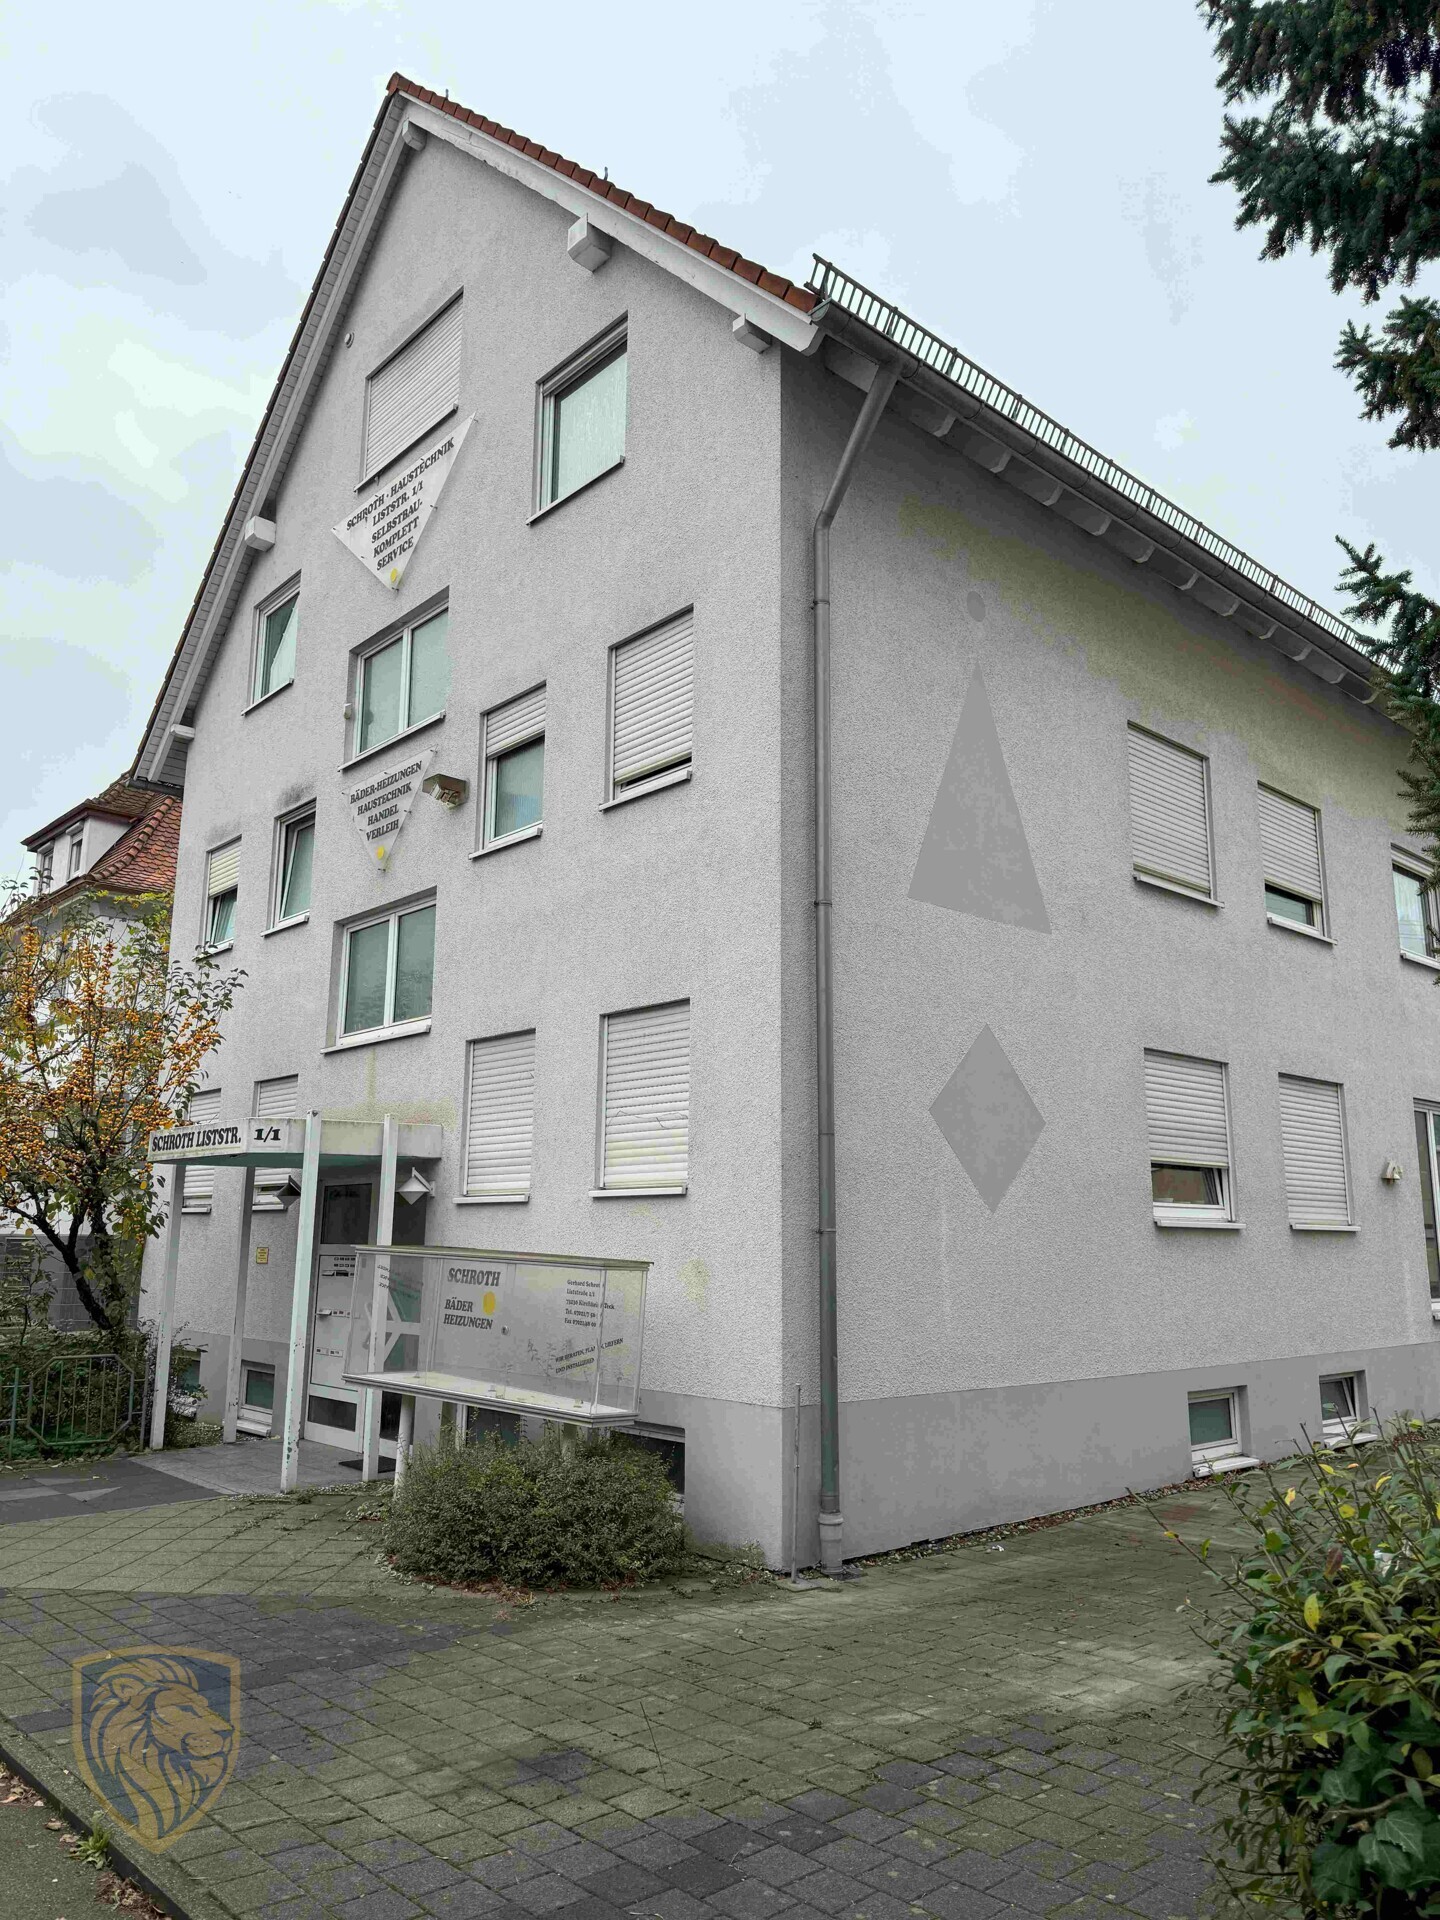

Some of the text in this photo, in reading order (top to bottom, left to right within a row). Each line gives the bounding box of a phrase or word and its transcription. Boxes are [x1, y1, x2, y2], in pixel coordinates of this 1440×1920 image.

[346, 437, 455, 531] SCHROTH HAUSTECHNIK
[373, 480, 423, 526] LISTSTR. 1/1
[373, 516, 419, 558] KOMPLETT
[376, 536, 414, 570] SERVICE
[350, 760, 422, 804] BÄDER-HEIZUNGEN
[357, 782, 412, 816] HAUSTECHNIK
[366, 819, 399, 841] VERLEIH
[367, 804, 399, 826] HANDEL
[152, 1126, 281, 1152] SCHROTH LISTSTR. 1/1
[447, 1267, 501, 1287] SCHROTH
[444, 1296, 473, 1313] BÄDER
[443, 1313, 493, 1330] HEIZUNGEN
